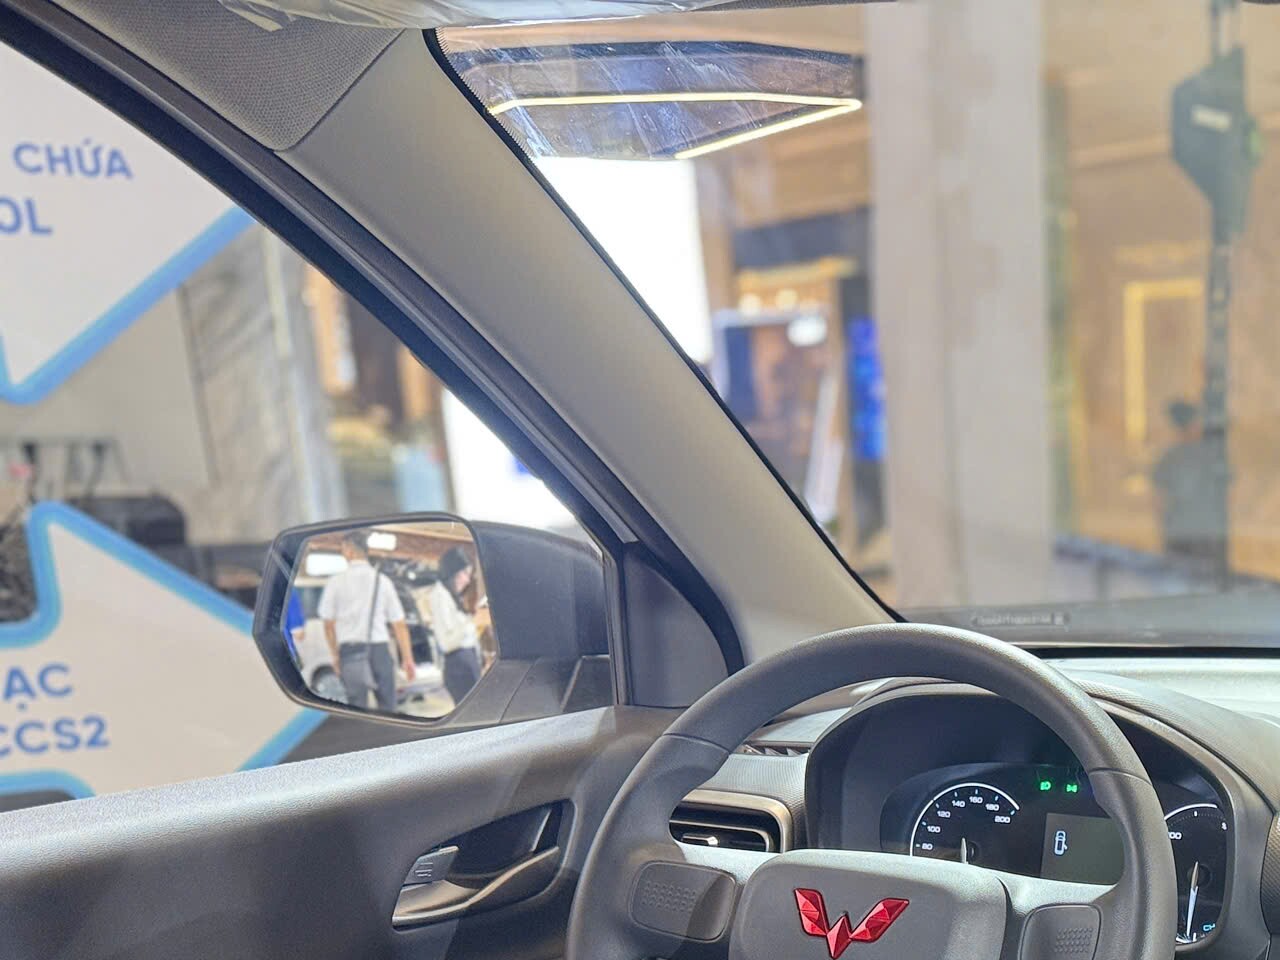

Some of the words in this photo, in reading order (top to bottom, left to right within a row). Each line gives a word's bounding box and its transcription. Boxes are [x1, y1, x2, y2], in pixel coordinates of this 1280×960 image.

[951, 800, 966, 808] 140
[969, 796, 983, 804] 160
[994, 815, 1011, 824] 200
[926, 825, 941, 833] 100
[1168, 832, 1182, 840] 00
